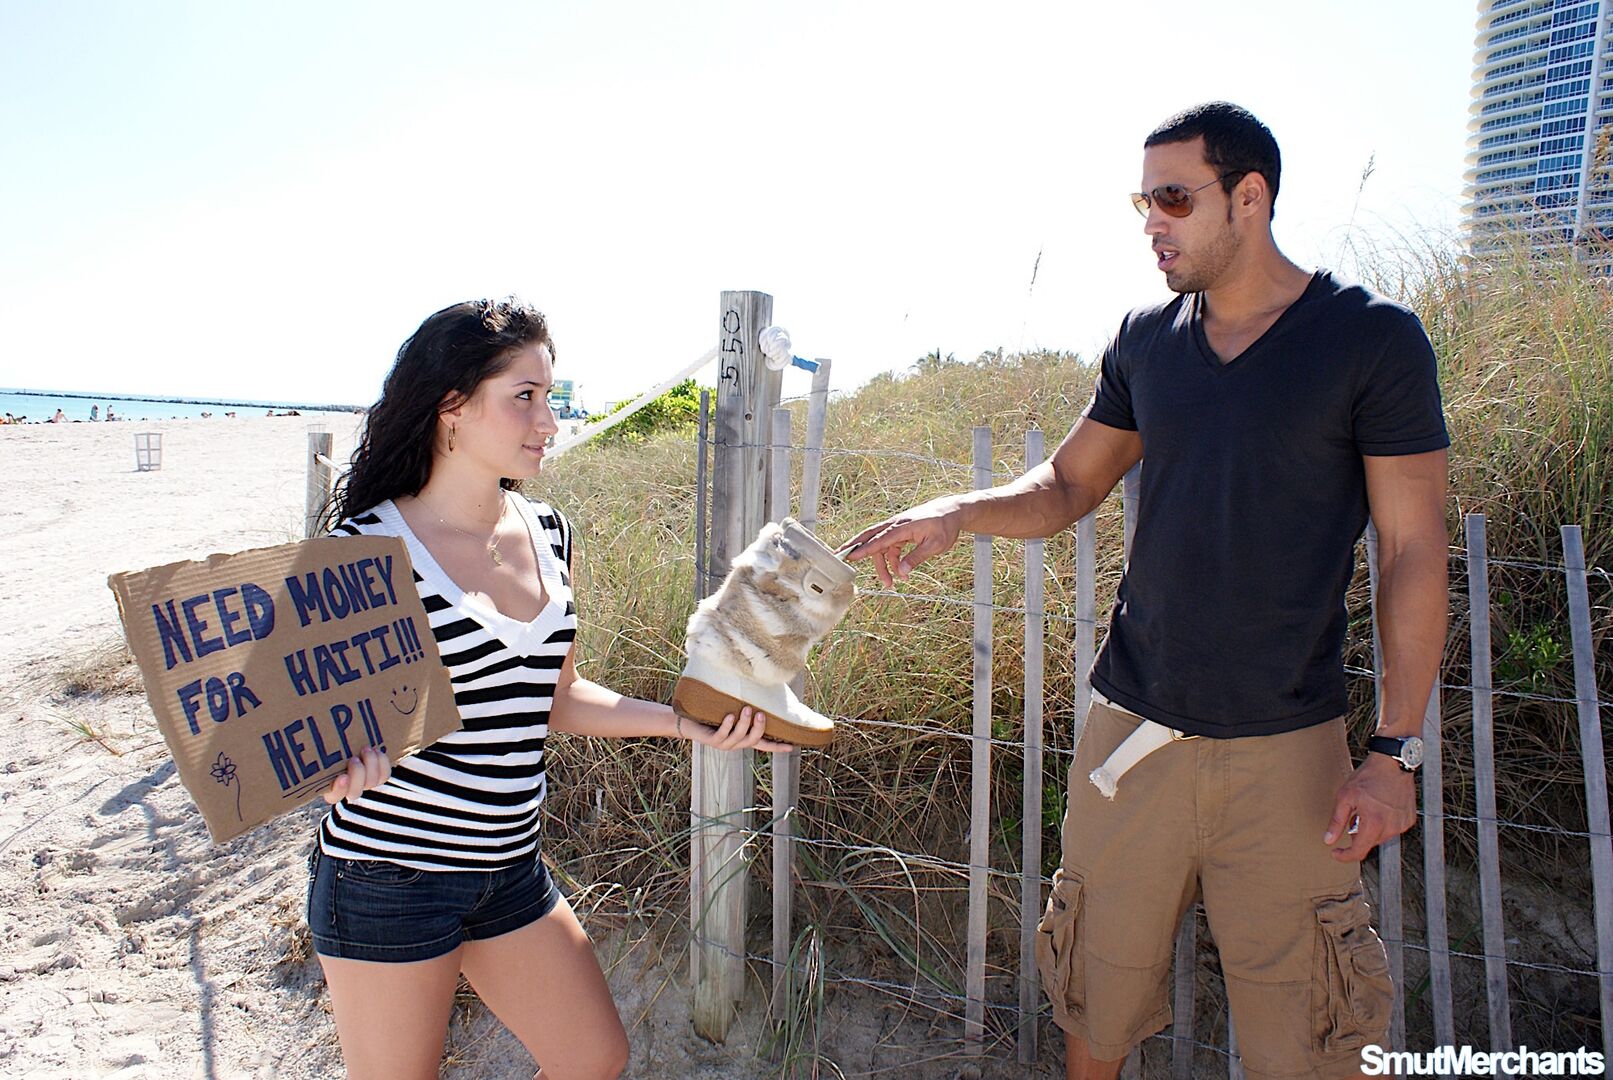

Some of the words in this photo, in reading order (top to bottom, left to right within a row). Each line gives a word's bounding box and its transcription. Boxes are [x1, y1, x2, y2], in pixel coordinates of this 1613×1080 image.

[720, 309, 744, 387] 550
[152, 583, 275, 670] NEED
[285, 555, 398, 627] MONEY
[177, 672, 262, 735] FOR
[284, 617, 425, 696] HAITI!!!
[262, 699, 387, 791] HELP!!
